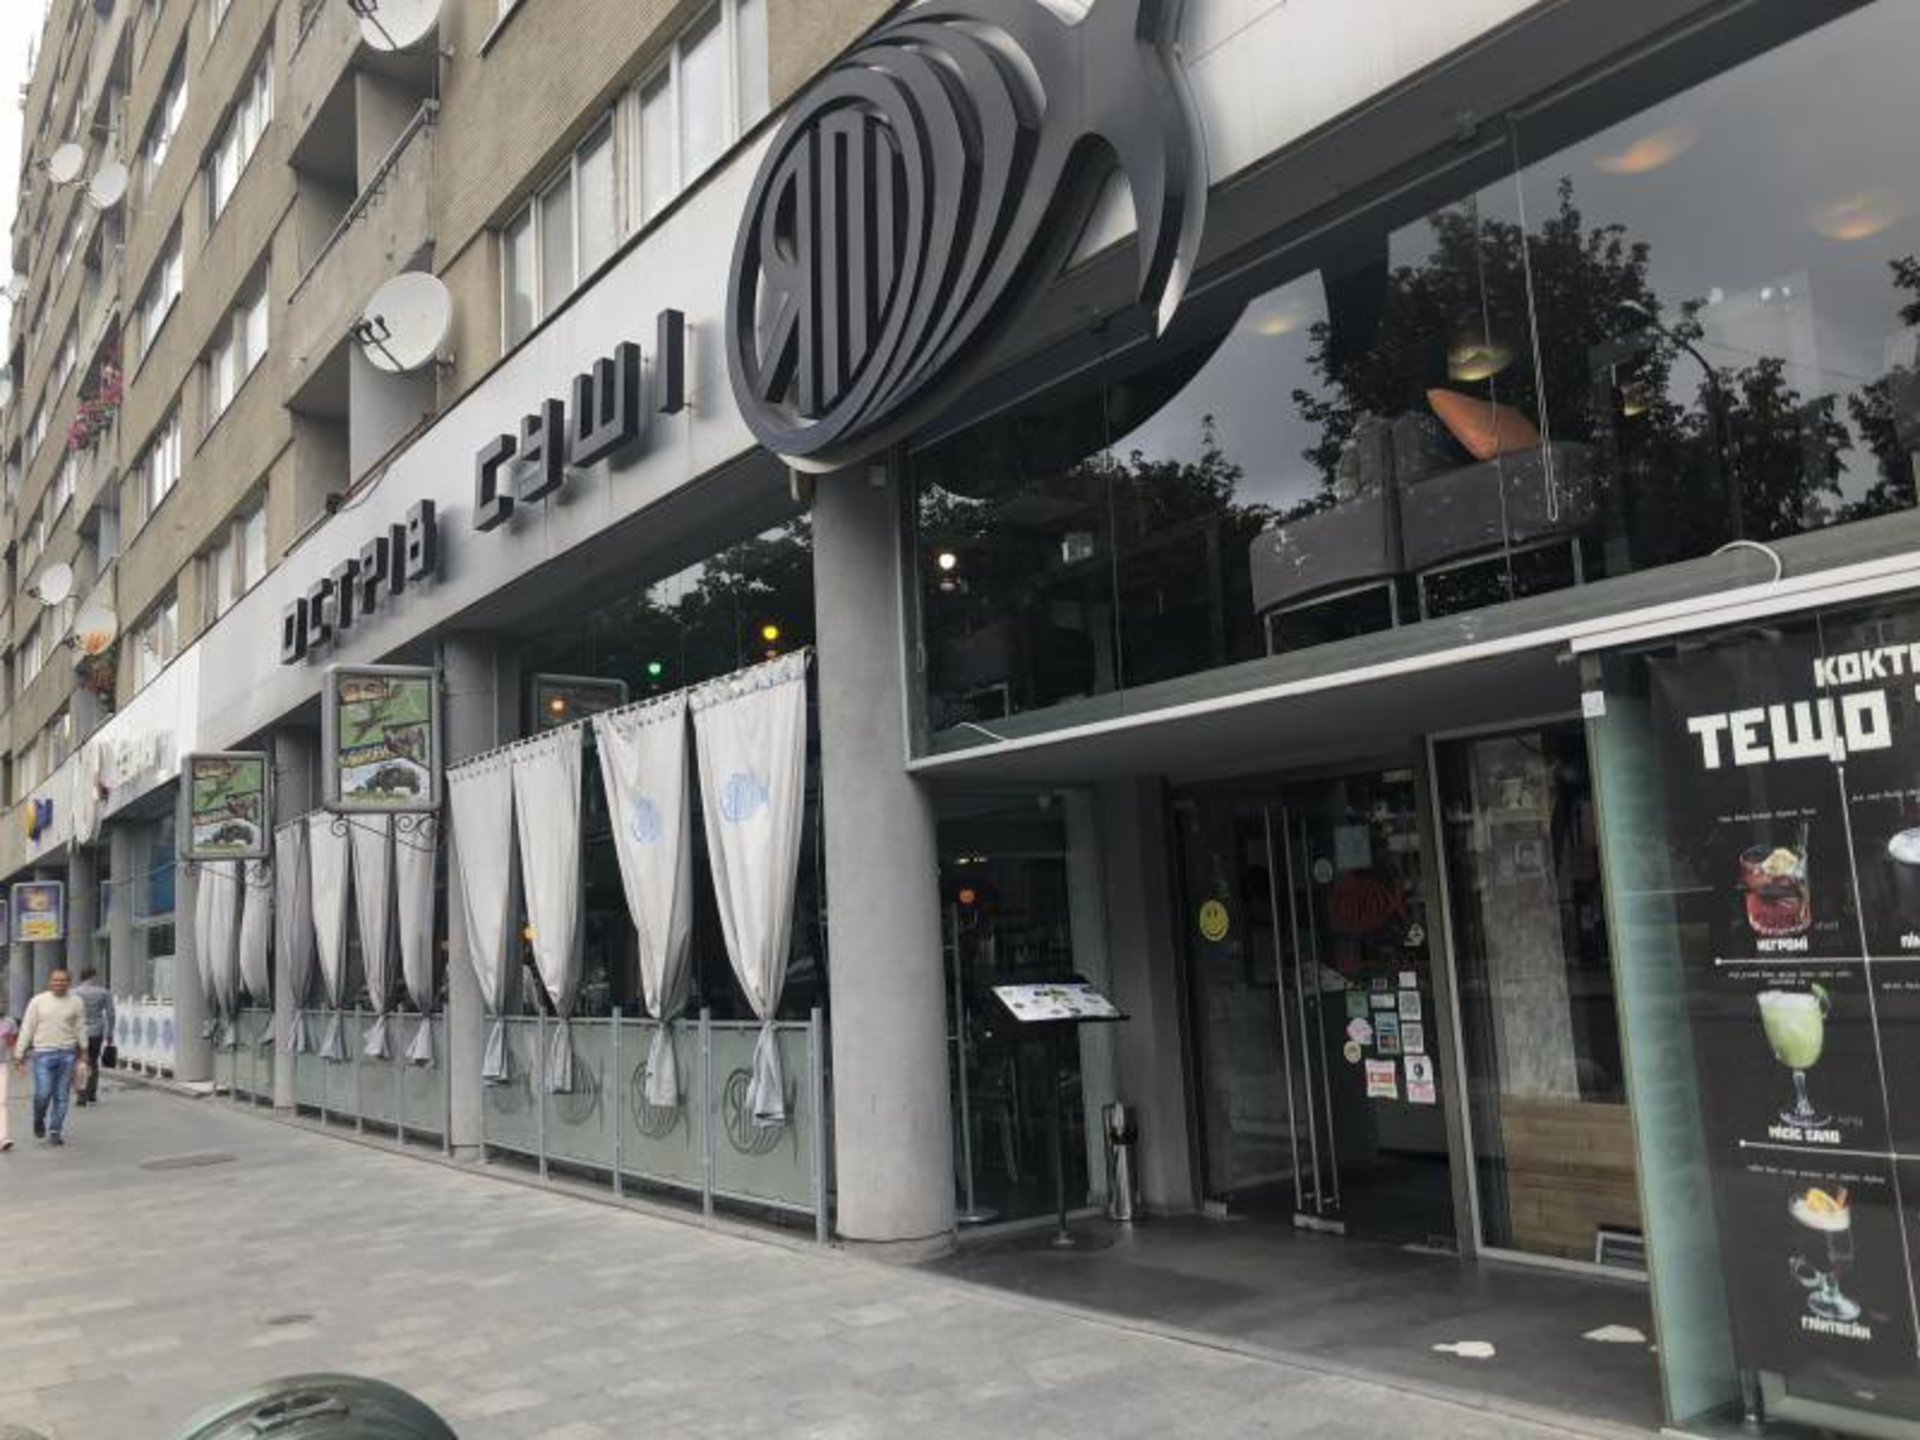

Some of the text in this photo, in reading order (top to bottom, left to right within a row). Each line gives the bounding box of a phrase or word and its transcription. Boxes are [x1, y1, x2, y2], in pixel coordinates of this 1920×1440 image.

[280, 307, 686, 665] ОСТРІВ СУШІ
[1686, 689, 1892, 769] ТЕЩО
